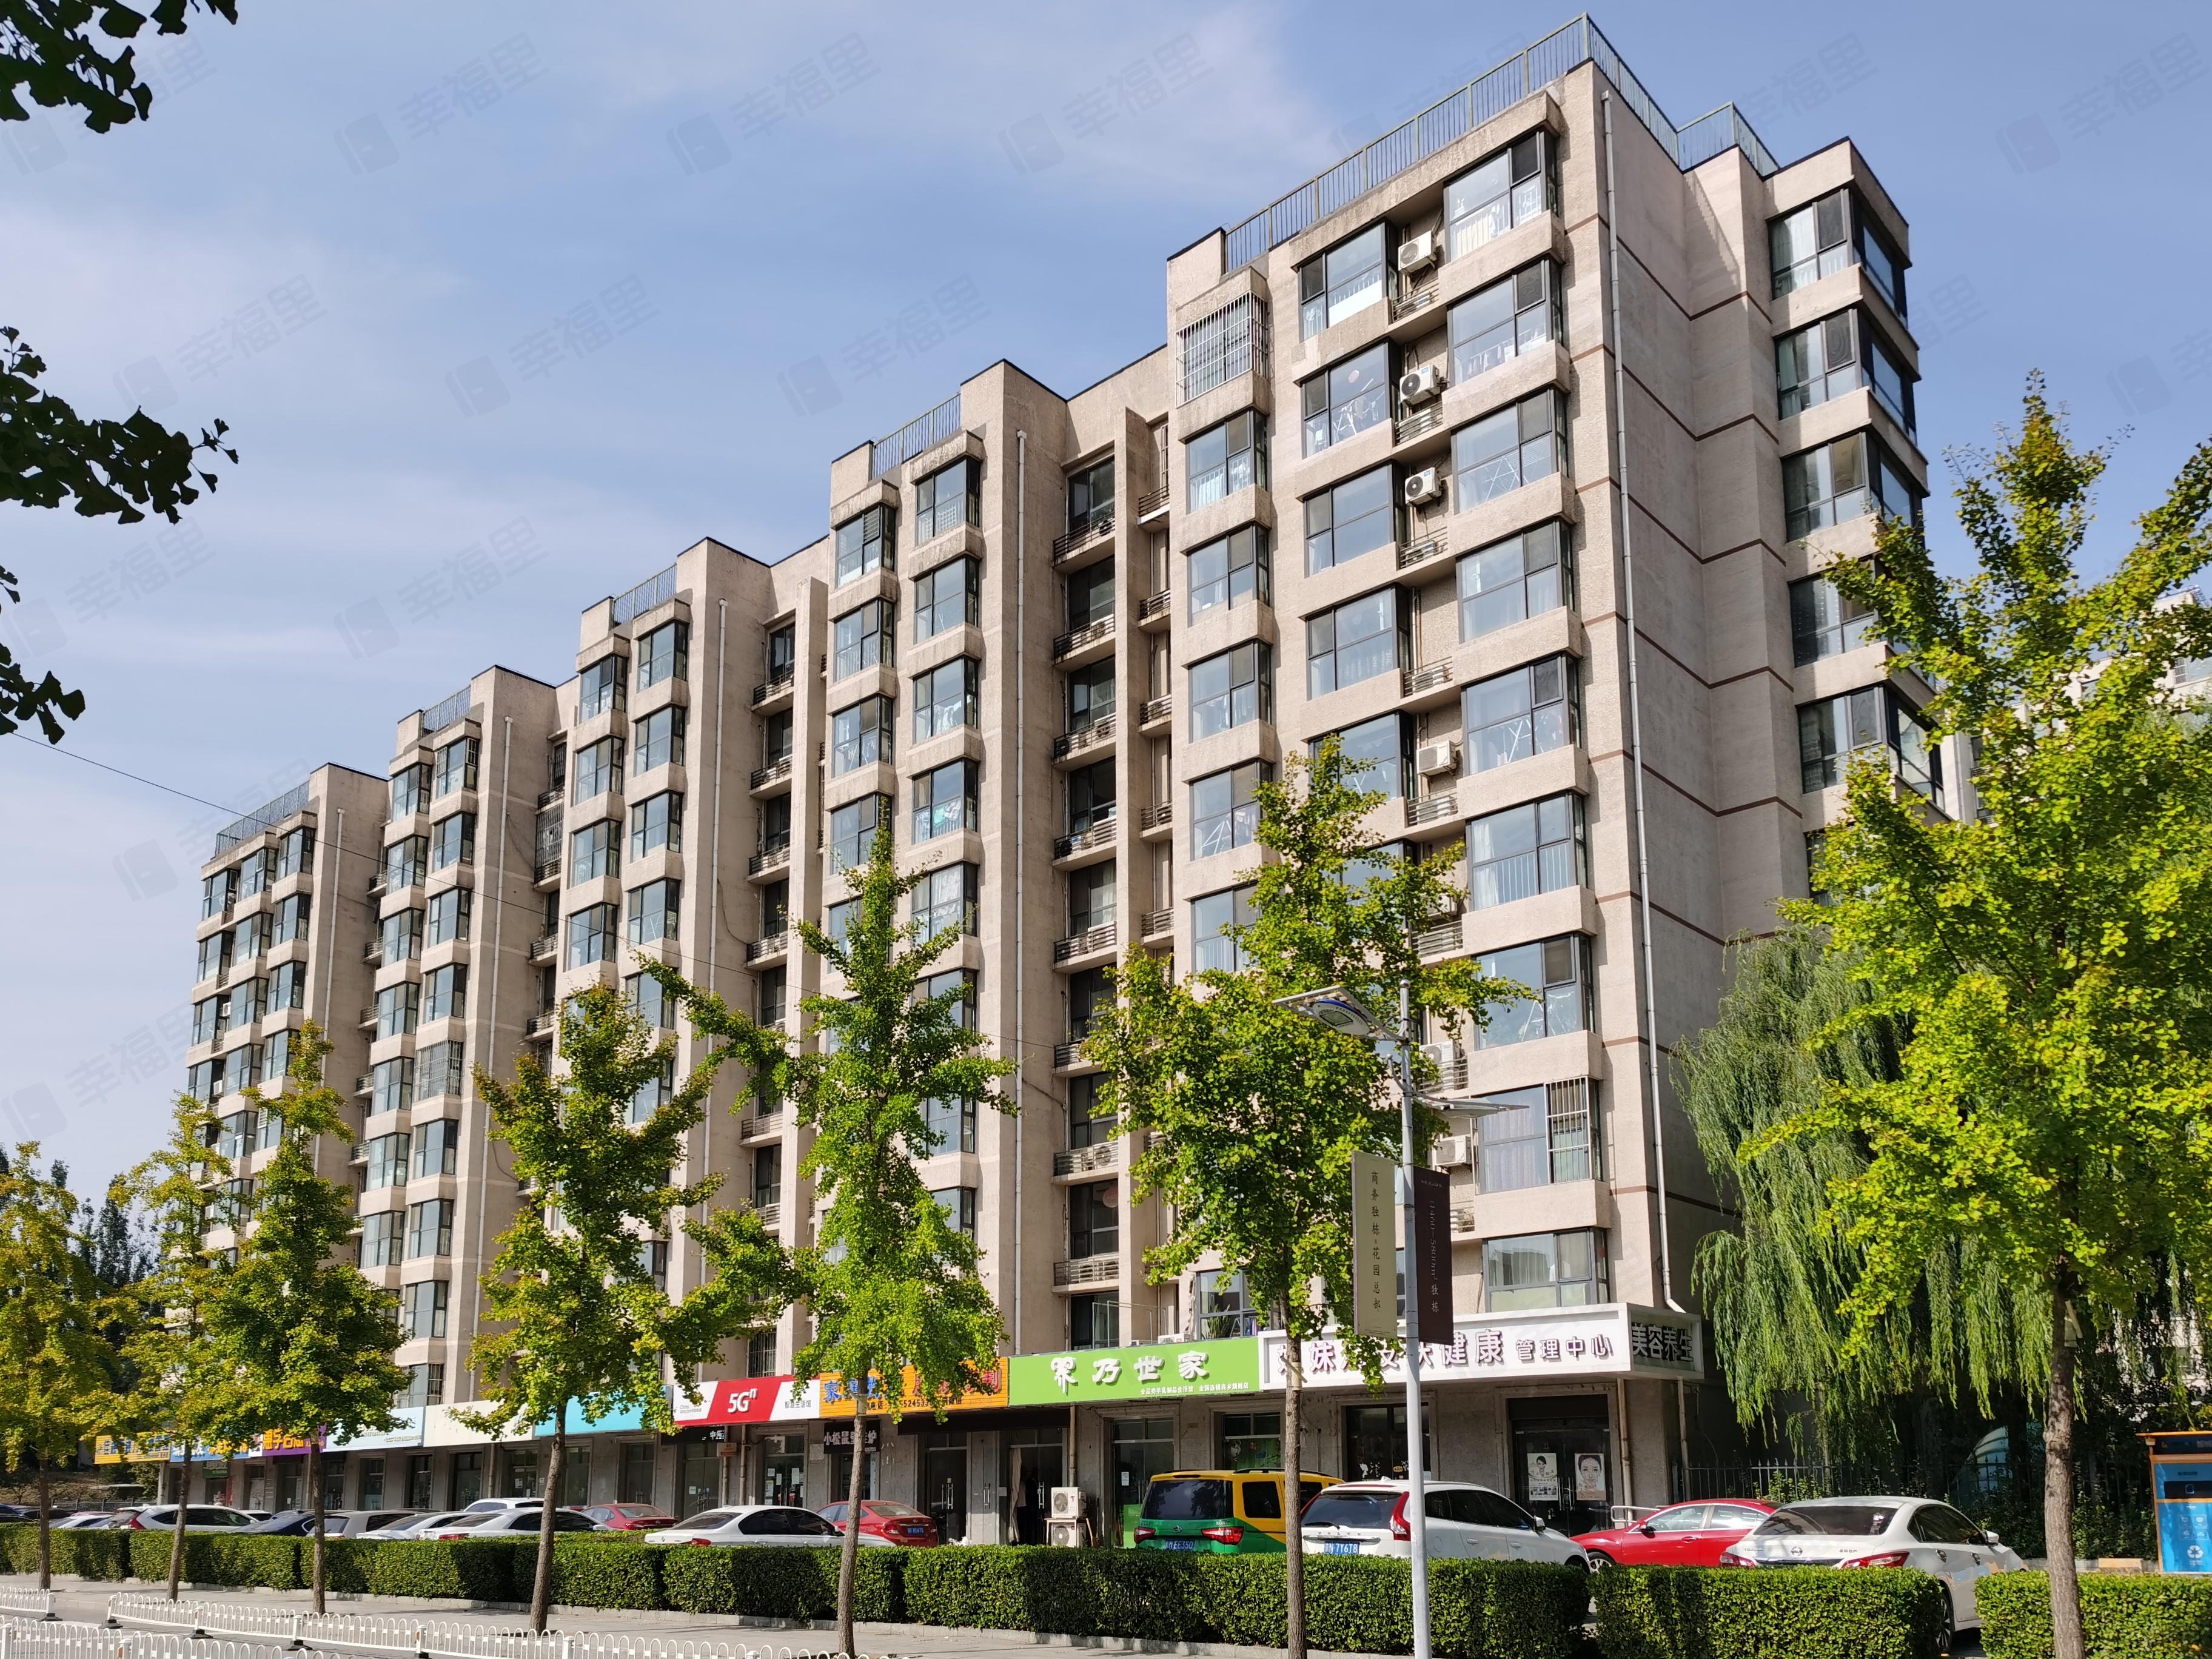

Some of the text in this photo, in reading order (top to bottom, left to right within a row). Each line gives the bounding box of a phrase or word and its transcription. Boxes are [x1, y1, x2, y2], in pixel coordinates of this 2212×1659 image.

[1371, 1171, 1379, 1236] 商务独栋
[1516, 1333, 1614, 1362] 管理中心
[1632, 1322, 1694, 1362] 美容养生
[823, 1430, 877, 1446] 小松鼠壁炉
